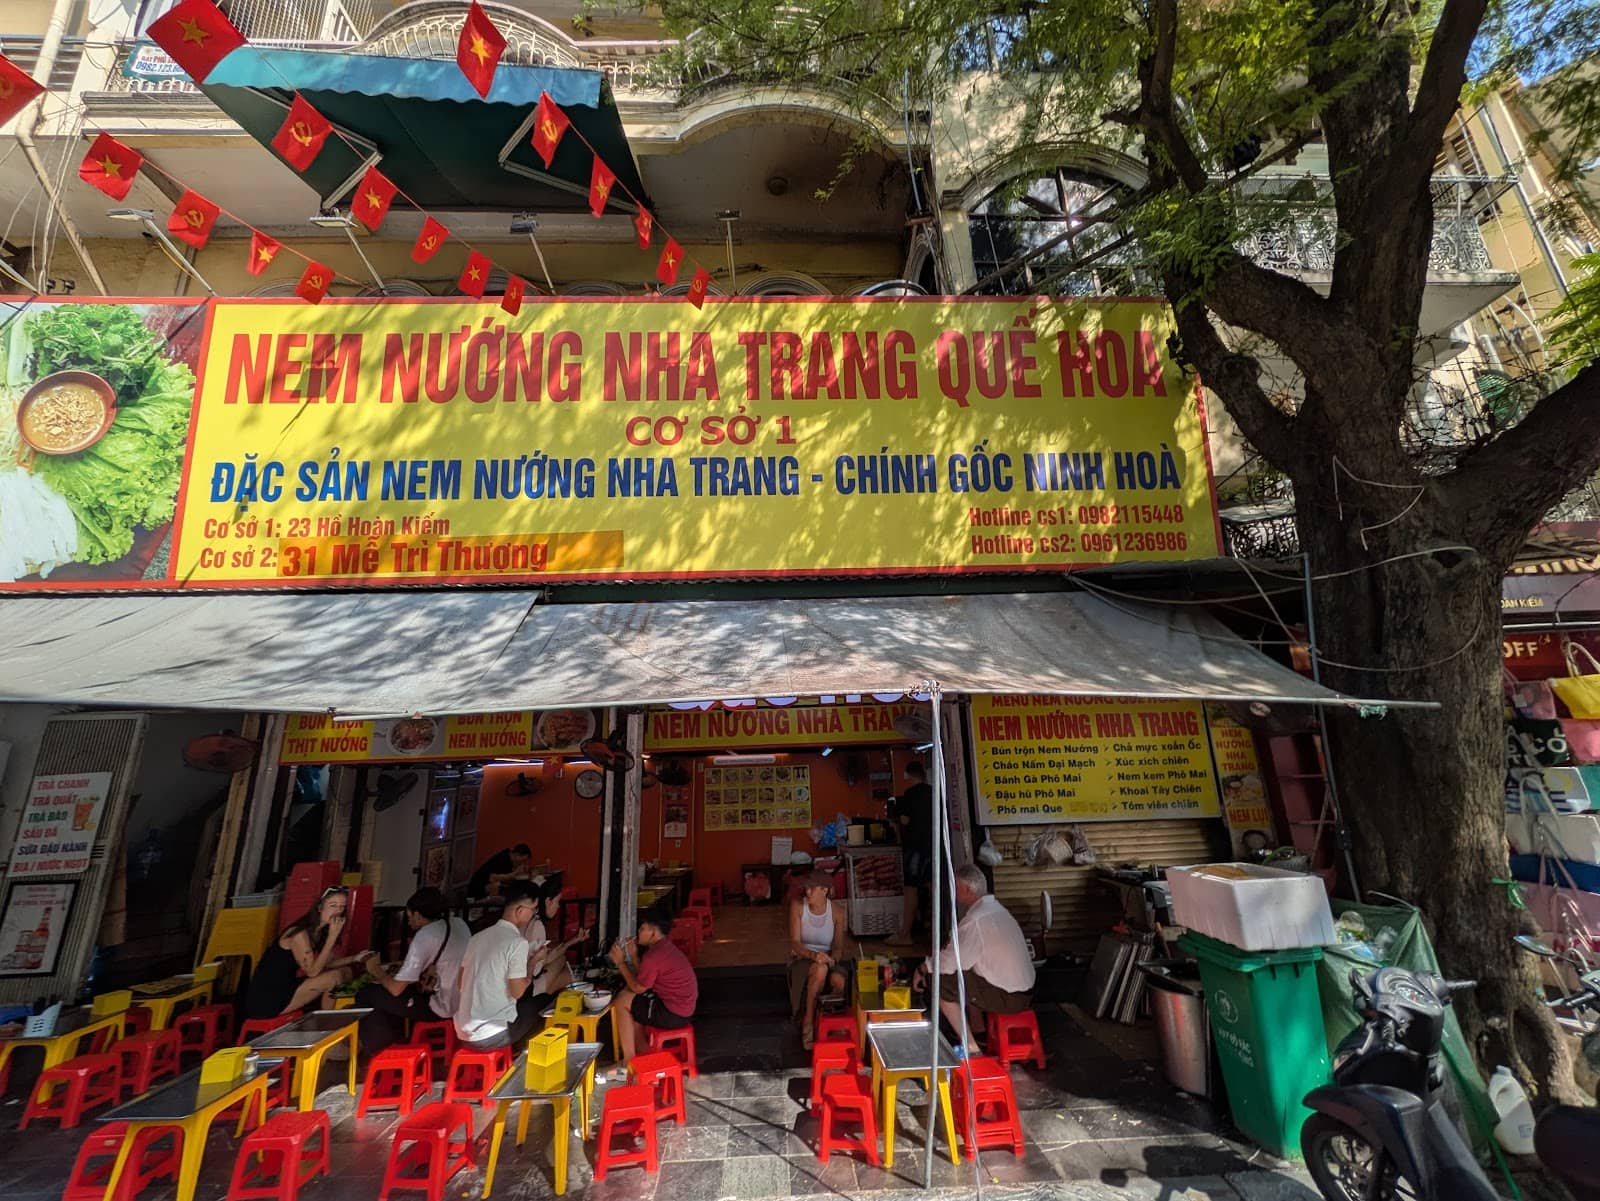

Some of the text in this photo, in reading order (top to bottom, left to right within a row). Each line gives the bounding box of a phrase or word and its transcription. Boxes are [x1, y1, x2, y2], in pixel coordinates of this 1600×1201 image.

[224, 308, 1167, 408] NEM NƯỚNG NHA TRANG QUẾ HOA
[625, 406, 797, 446] CƠ SỞ 1
[210, 439, 1181, 513] ĐẶC SẢN NEM NƯỚNG NHA TRANG - CHÍNH GỐC NINH HOÀ
[204, 509, 451, 539] Cơ sở 1: 23 Hồ Hoàn Kiếm
[969, 504, 1185, 527] Hotline cs1: 0982115448
[971, 531, 1188, 555] Hotline cs2: 0961236986
[200, 535, 549, 577] Cơ sở 2: 31 Mễ Trì Thượng
[653, 711, 701, 739] NEM
[796, 707, 844, 735] NHA
[978, 709, 1200, 741] NEM NƯỚNG NHA TRANG
[287, 732, 368, 757] THỊT NƯỚNG
[449, 727, 527, 749] NEM NƯỚNG
[991, 743, 1099, 757] Bún trộn Nem Nướng
[1048, 760, 1065, 771] Đại
[1067, 759, 1096, 771] Mạch
[1117, 772, 1140, 782] Nem
[1189, 770, 1207, 779] Mai
[1062, 774, 1082, 783] Mai
[995, 790, 1016, 802] Đậu
[1057, 789, 1076, 798] Mai
[1119, 786, 1150, 796] Khoai
[1020, 804, 1040, 814] mai
[1042, 804, 1063, 814] Que
